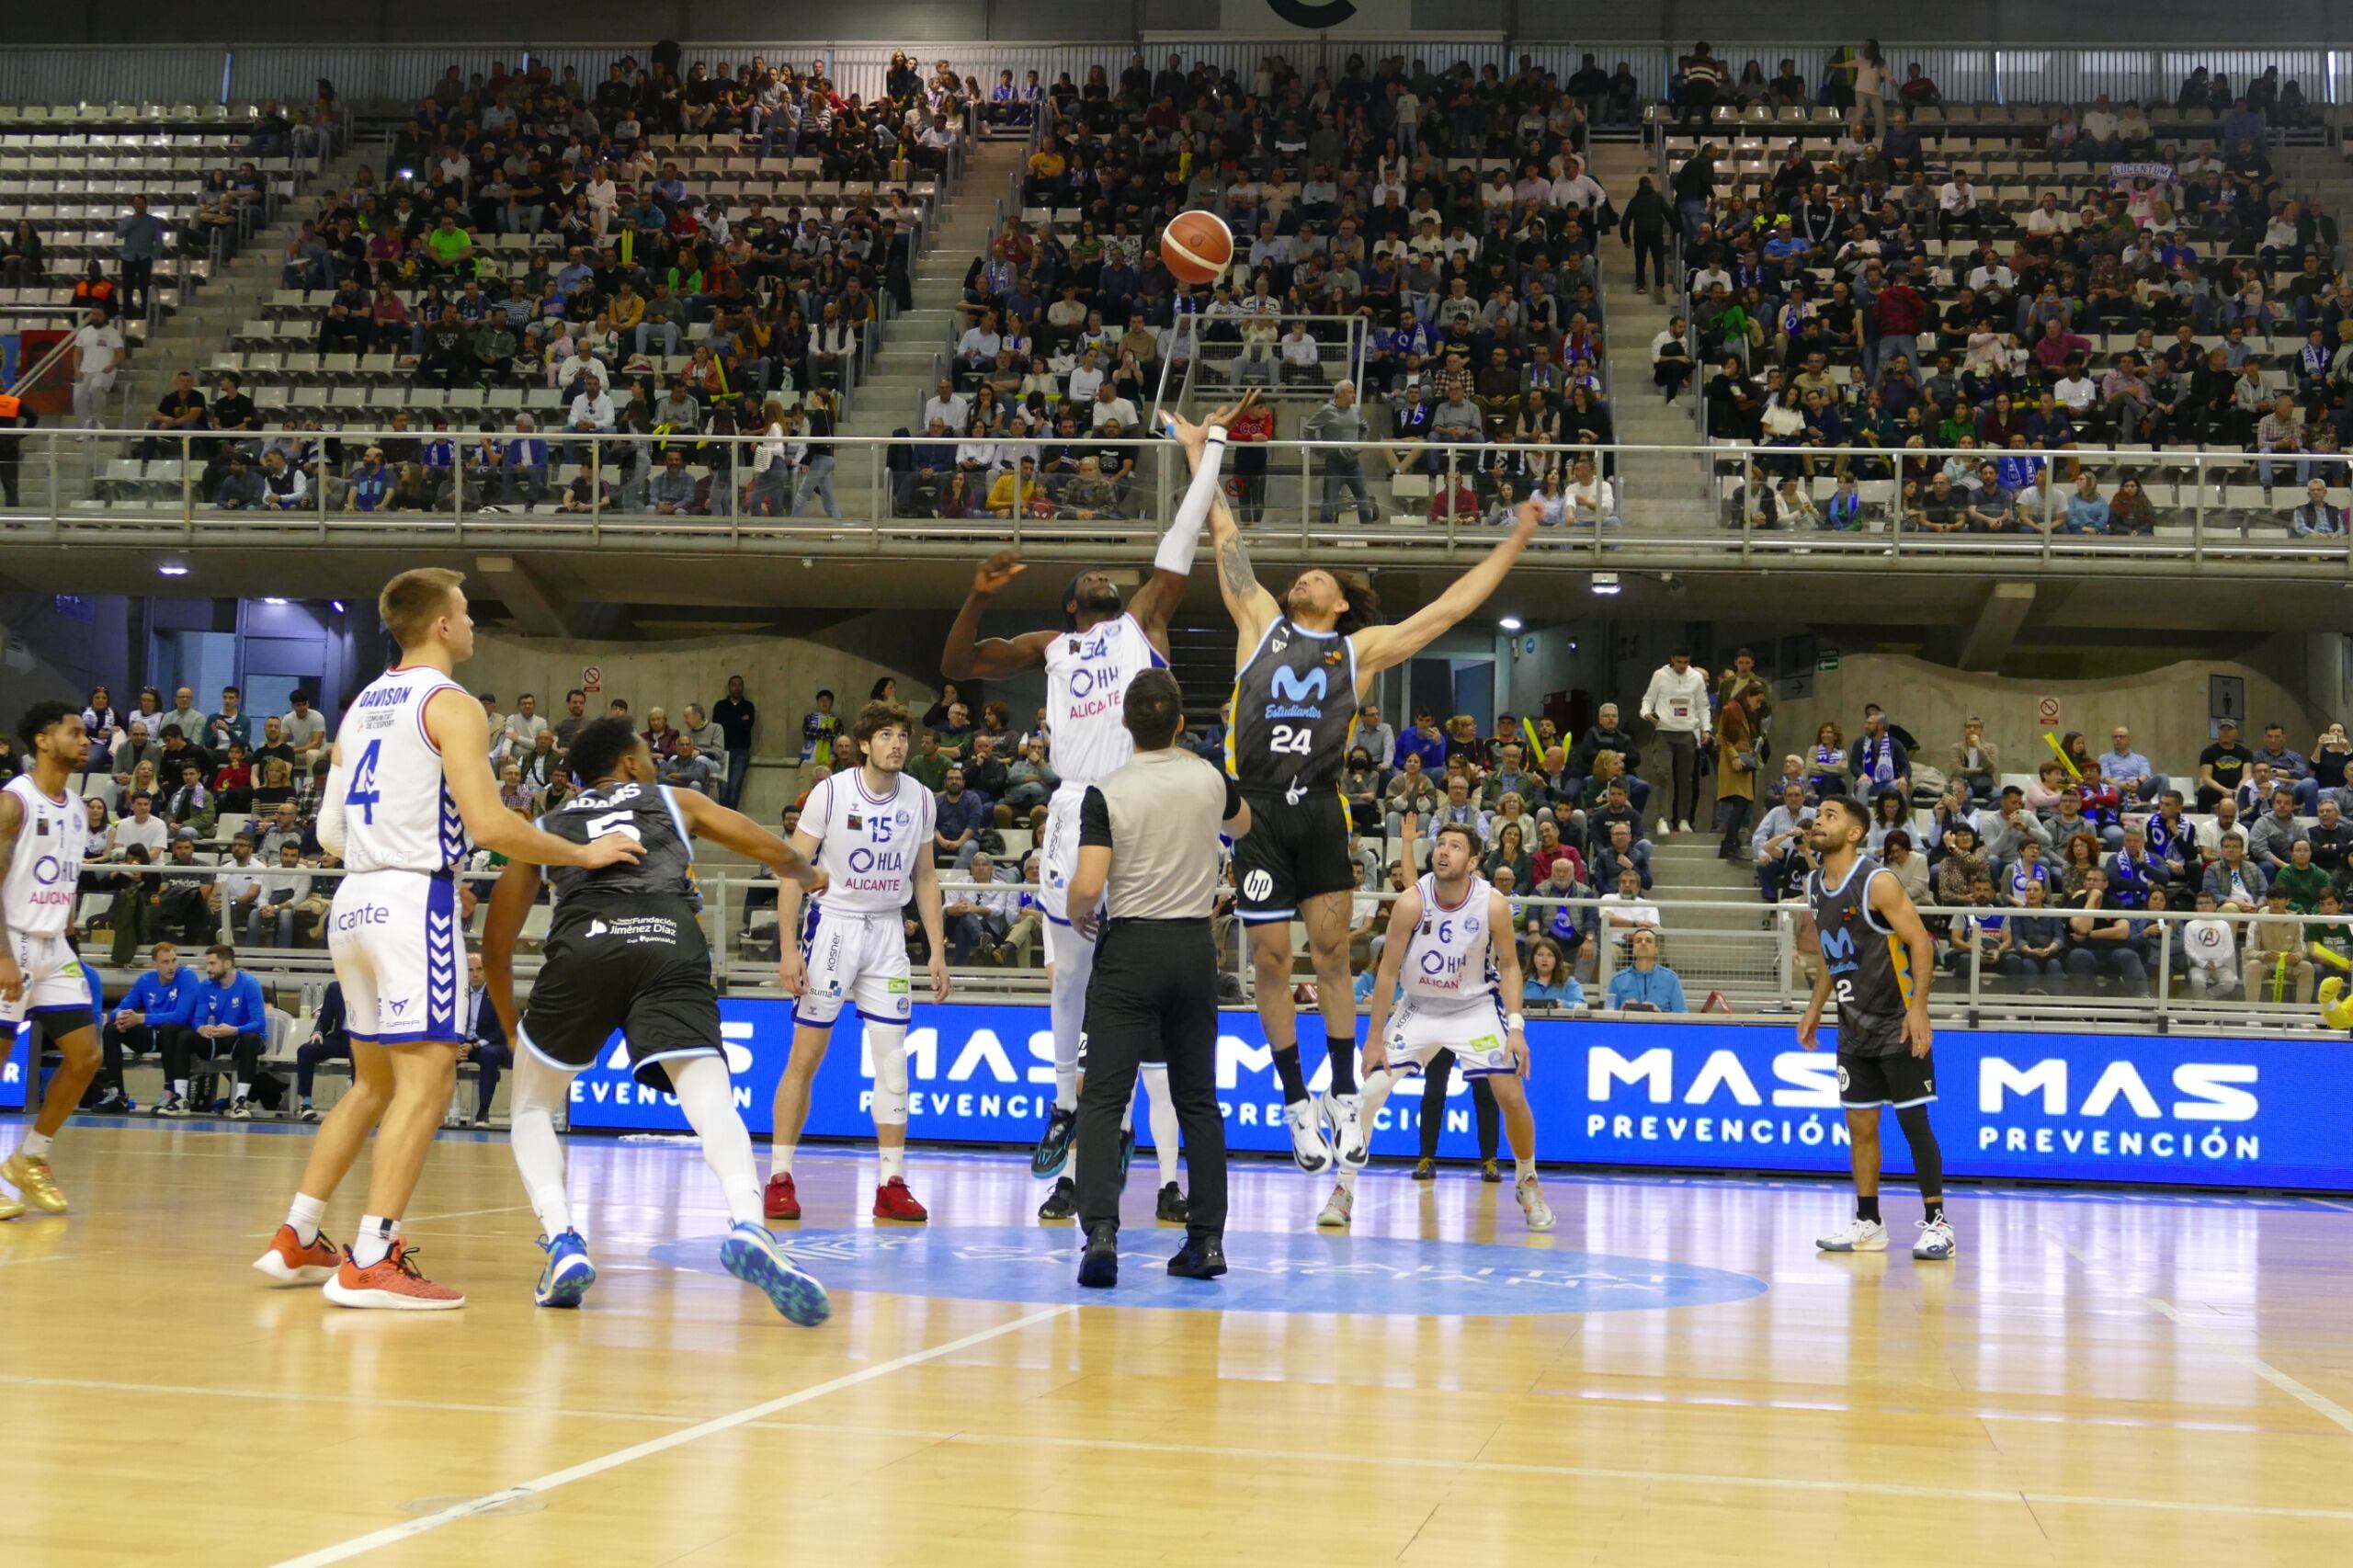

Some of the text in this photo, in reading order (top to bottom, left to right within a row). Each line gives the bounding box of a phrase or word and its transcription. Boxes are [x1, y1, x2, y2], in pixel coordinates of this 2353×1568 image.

[2114, 165, 2168, 176] LUCENTUM
[1081, 637, 1108, 660] 34
[359, 687, 413, 708] DAVISON
[1069, 690, 1121, 720] ALICATE
[1265, 704, 1322, 719] Estudiantes
[1270, 724, 1312, 756] 24
[345, 739, 381, 825] 4
[563, 782, 642, 811] ADAMS
[56, 819, 64, 848] 1
[585, 810, 641, 843] 5
[868, 816, 892, 843] 15
[877, 852, 902, 871] HLA
[846, 877, 901, 892] ALICANTE
[1247, 869, 1269, 901] hp
[609, 923, 676, 937] Jiménez Díaz
[632, 916, 676, 928] Fundación
[1438, 920, 1452, 944] 6
[826, 931, 841, 971] kosner
[809, 987, 833, 998] suma
[1418, 971, 1463, 989] ALICAN
[1836, 979, 1855, 1003] 2
[1588, 1046, 1841, 1108] MAS
[1979, 1056, 2259, 1121] MAS
[1587, 1113, 1851, 1146] PREVENCIÓN
[1979, 1125, 2259, 1160] PREVENCIÓN
